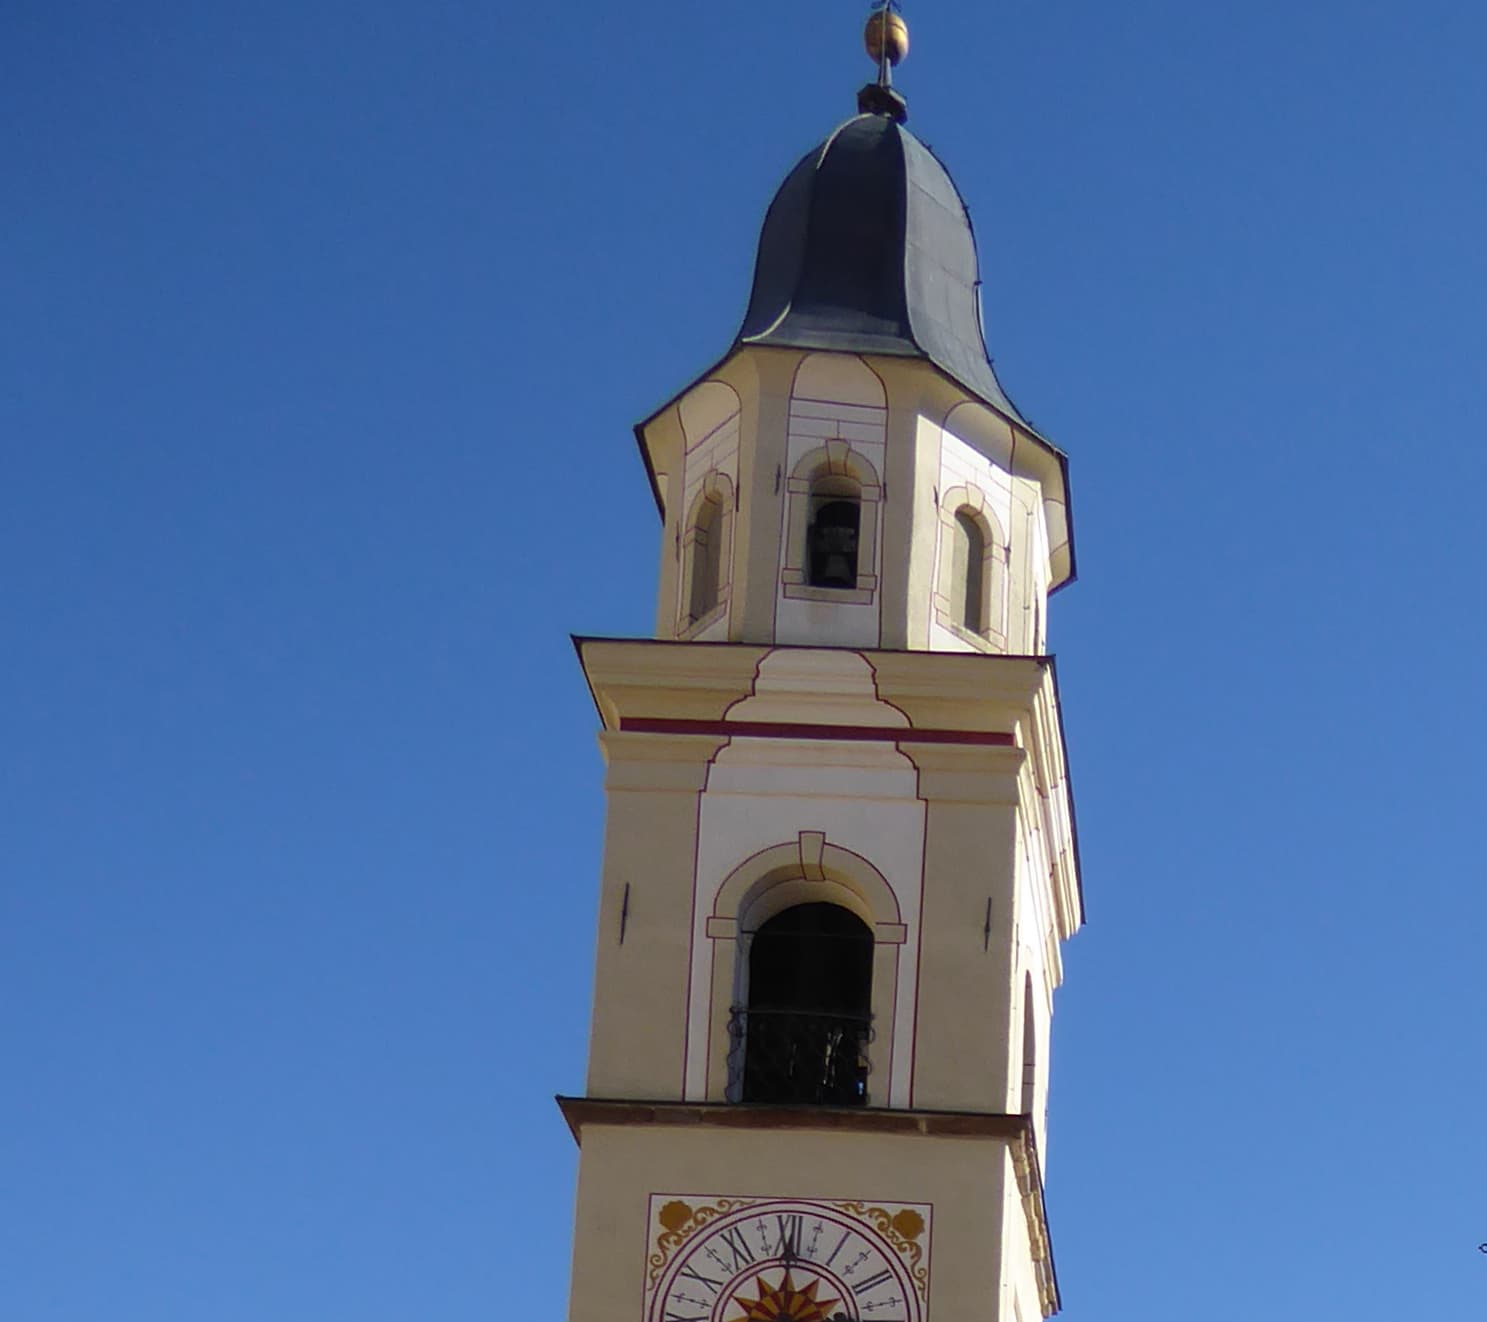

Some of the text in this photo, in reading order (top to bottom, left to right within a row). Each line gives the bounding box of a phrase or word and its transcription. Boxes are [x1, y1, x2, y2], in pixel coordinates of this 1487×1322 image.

[720, 1227, 755, 1271] XI
[681, 1265, 723, 1294] X
[852, 1269, 893, 1294] II
